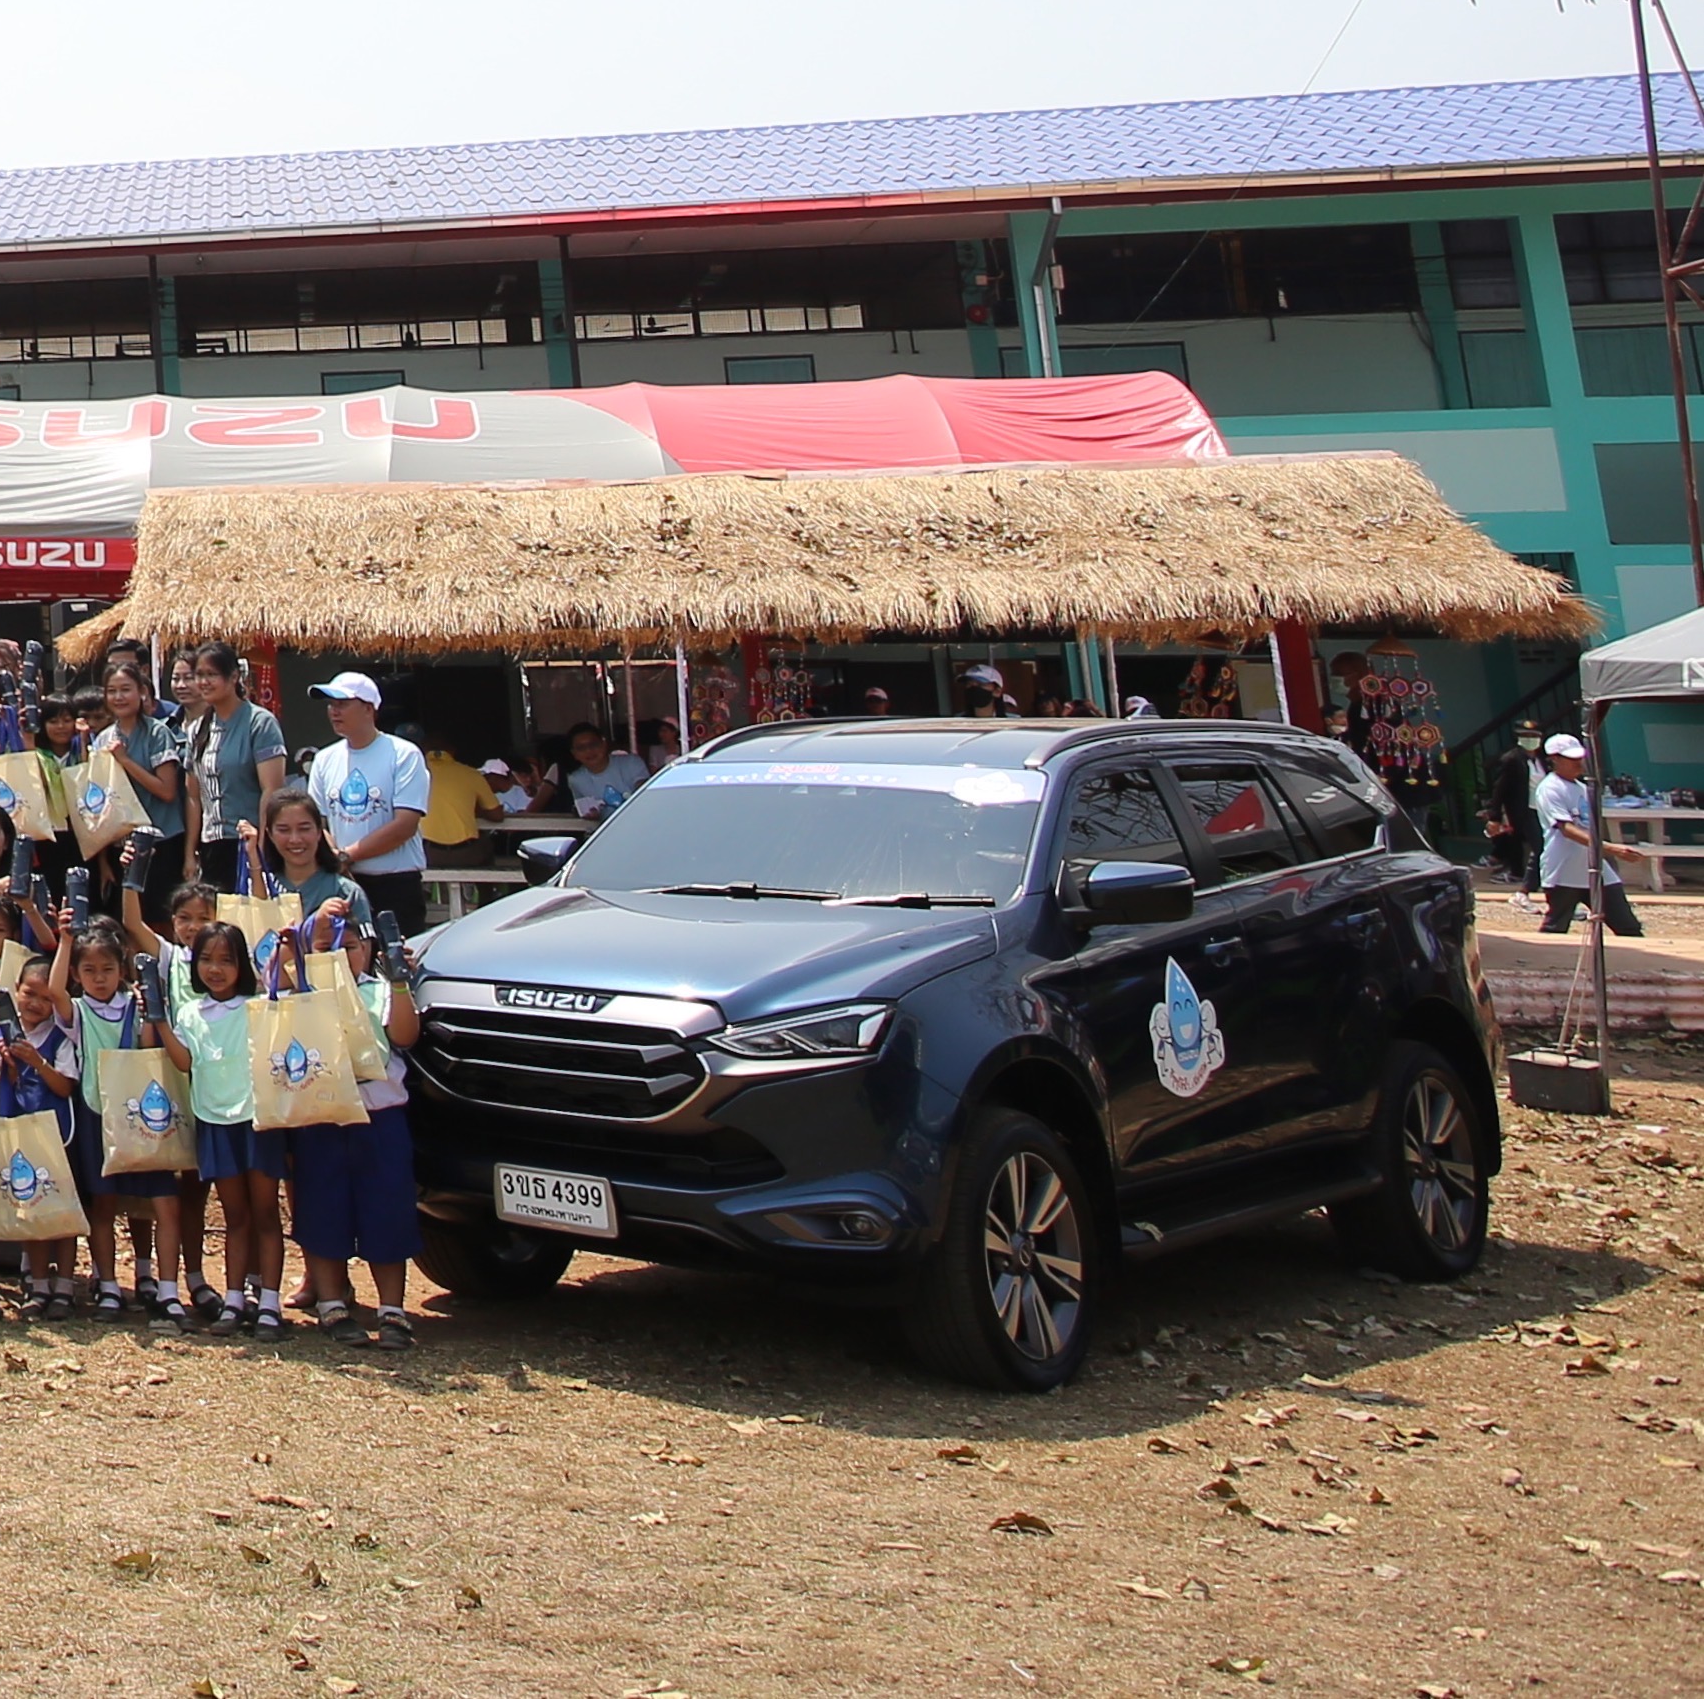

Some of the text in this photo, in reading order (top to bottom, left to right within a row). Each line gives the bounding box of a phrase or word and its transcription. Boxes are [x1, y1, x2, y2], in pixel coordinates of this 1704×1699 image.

[508, 988, 596, 1010] ISUZU
[503, 1172, 602, 1208] 3ขธ 4399
